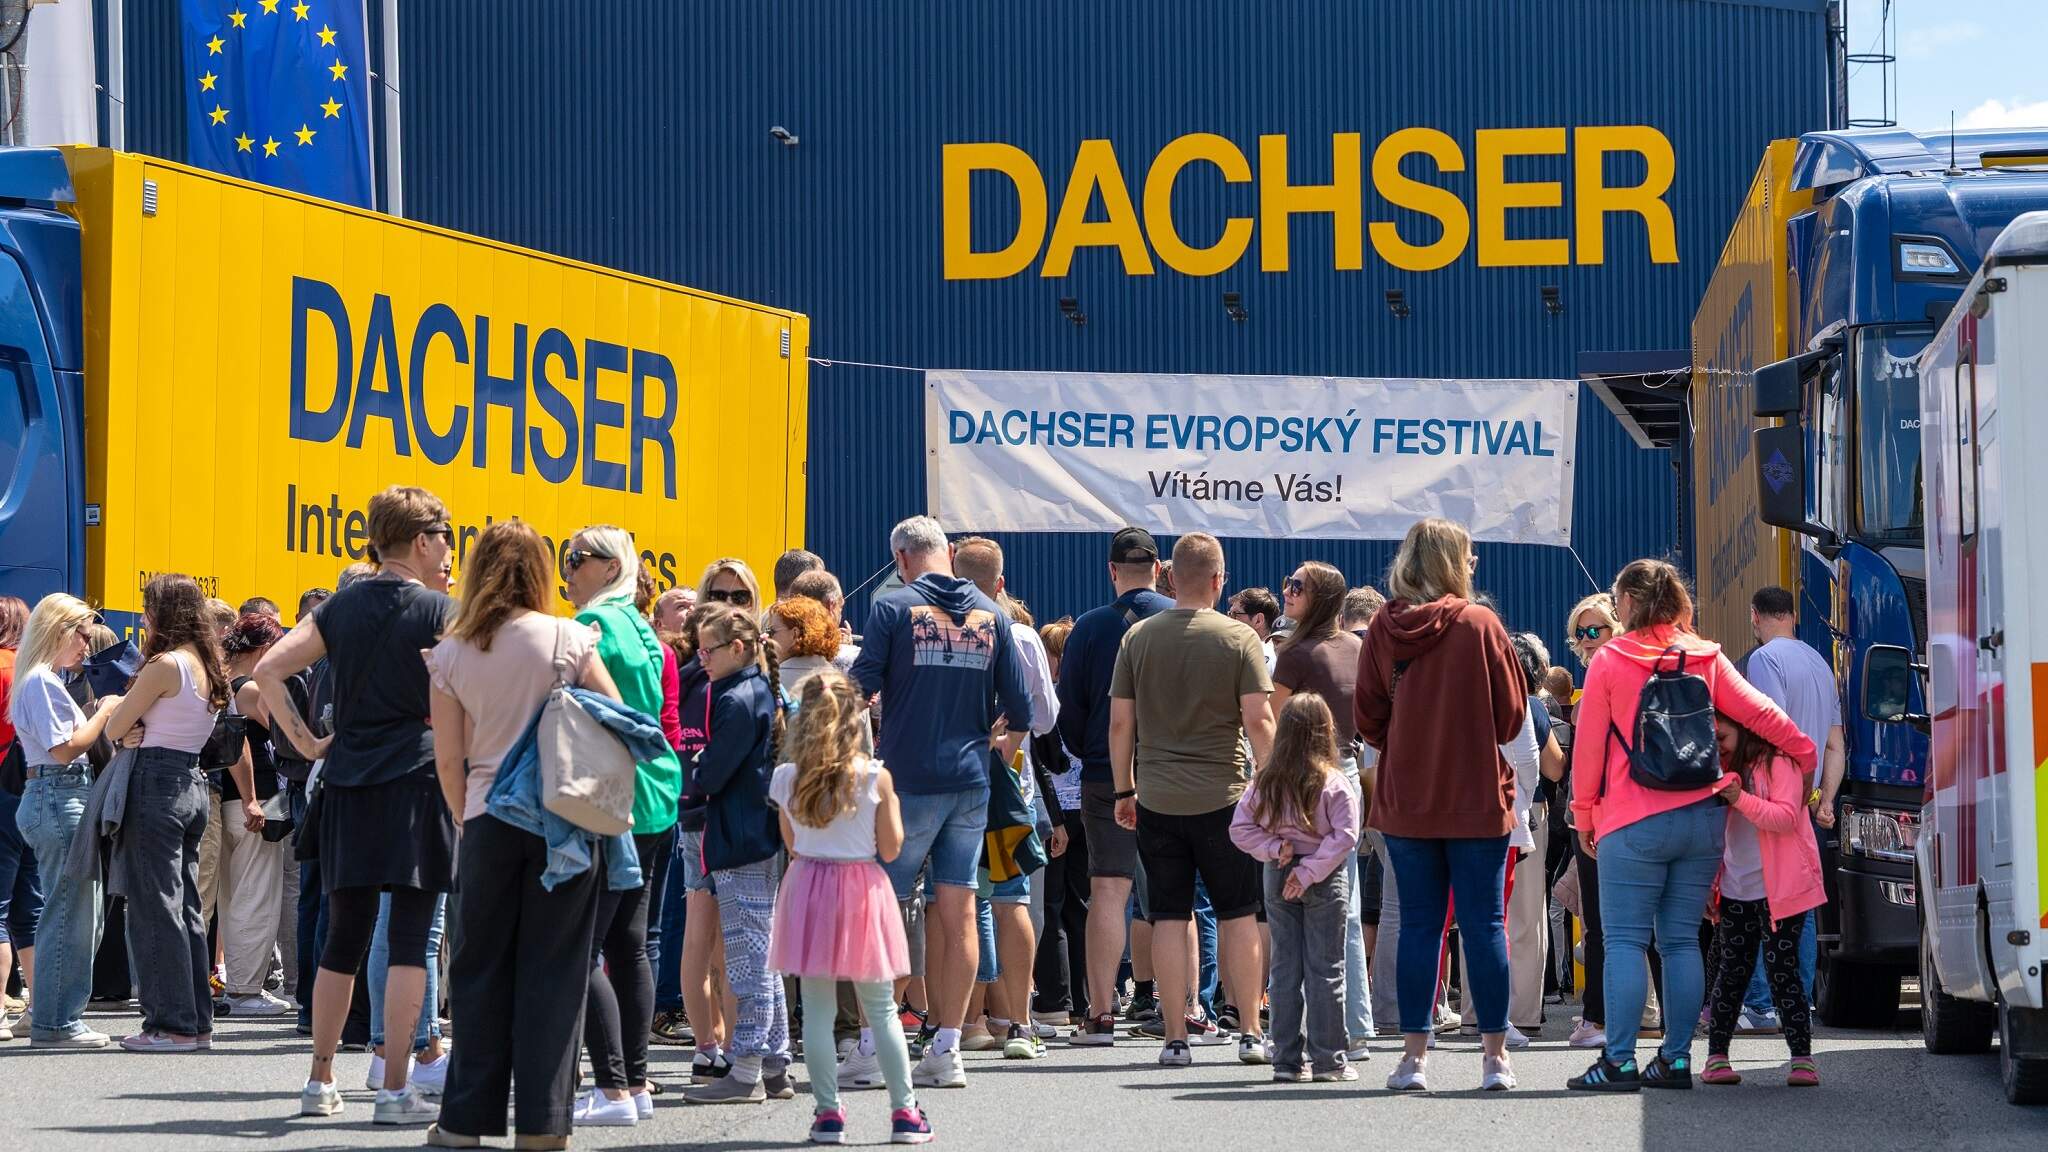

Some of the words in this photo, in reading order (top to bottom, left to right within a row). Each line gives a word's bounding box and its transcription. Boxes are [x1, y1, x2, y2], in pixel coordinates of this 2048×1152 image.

[943, 126, 1680, 280] DACHSER
[289, 275, 679, 500] DACHSER
[949, 410, 1134, 448] DACHSER
[1146, 409, 1361, 453] EVROPSKÝ
[1373, 418, 1555, 457] FESTIVAL
[1148, 470, 1264, 502] Vítáme
[1275, 473, 1343, 503] Vás!
